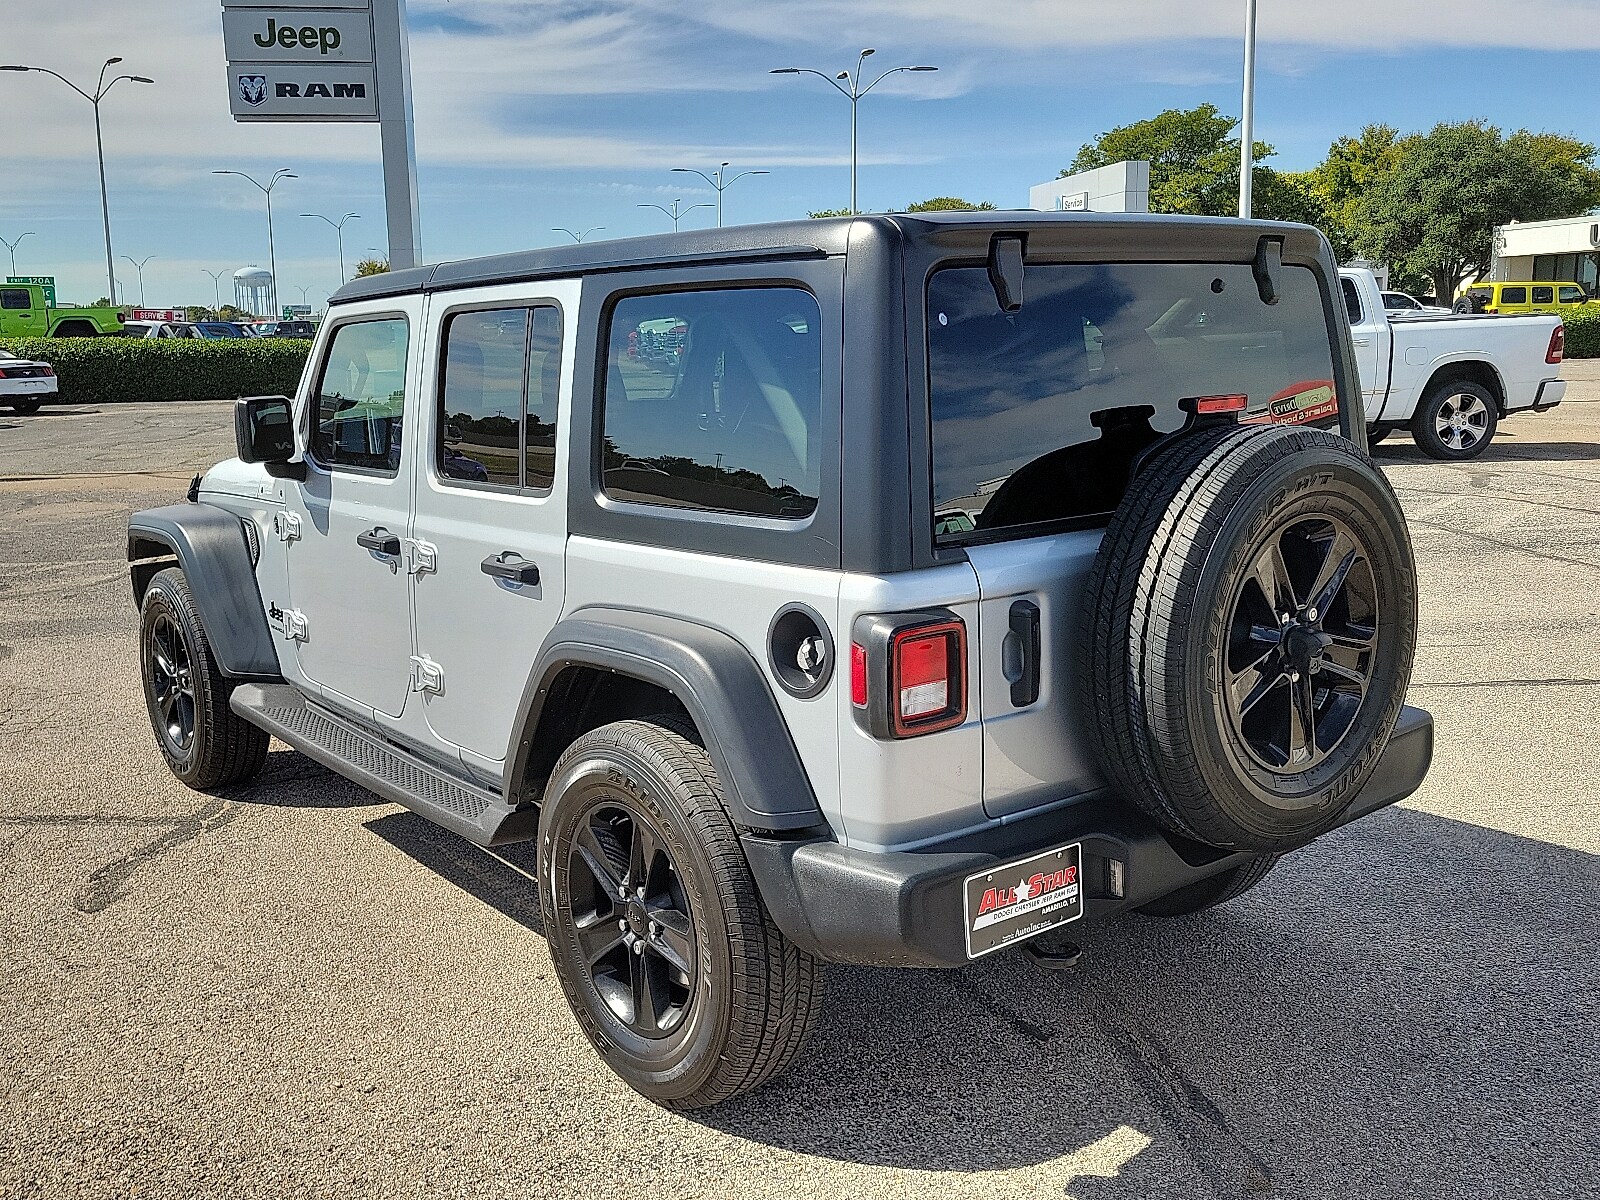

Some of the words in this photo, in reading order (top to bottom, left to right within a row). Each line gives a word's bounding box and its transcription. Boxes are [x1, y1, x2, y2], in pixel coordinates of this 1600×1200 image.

[253, 18, 341, 55] Jeep
[274, 82, 366, 99] RAM
[1064, 198, 1083, 210] Service
[28, 277, 51, 285] 120A
[140, 311, 168, 320] SERVICE
[977, 886, 1018, 915] ALL
[1027, 865, 1077, 898] STAR
[993, 908, 1013, 920] DODGE
[1014, 899, 1040, 913] CHRYSLER
[1053, 889, 1066, 901] RAM
